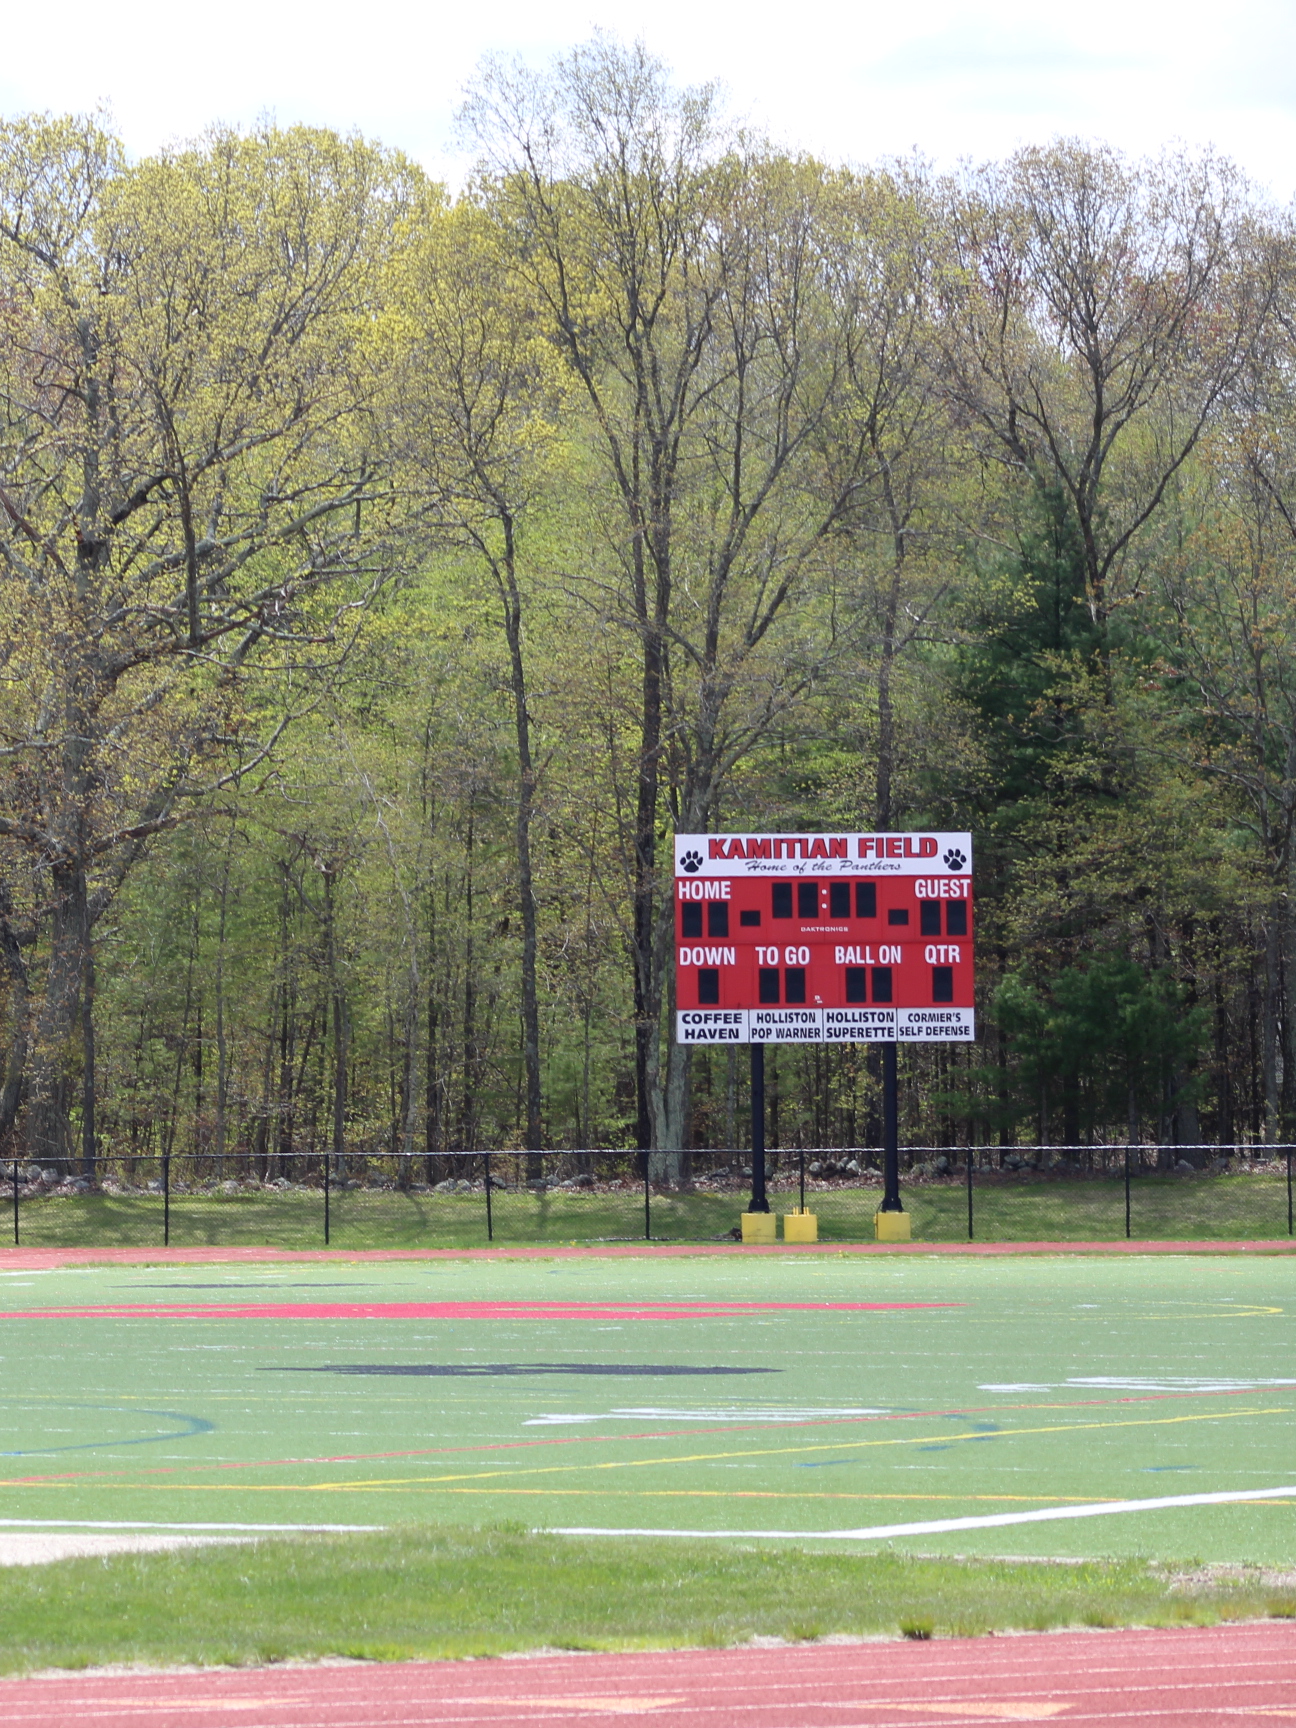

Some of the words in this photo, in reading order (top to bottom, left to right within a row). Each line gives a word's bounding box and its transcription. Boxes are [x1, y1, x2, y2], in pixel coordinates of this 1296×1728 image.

[708, 837, 848, 860] KAMITIAN
[858, 837, 939, 859] FIELD
[745, 860, 787, 873] Home
[792, 860, 808, 875] of
[811, 859, 834, 872] the
[839, 859, 902, 872] Panthers
[678, 881, 732, 900] HOME
[914, 879, 971, 898] GUEST
[679, 946, 736, 966] DOWN
[755, 946, 779, 965] TO
[785, 946, 810, 965] GO
[835, 946, 875, 965] BALL
[879, 945, 902, 964] ON
[924, 945, 961, 964] QTR
[681, 1012, 743, 1025] COFFEE
[756, 1012, 816, 1024] HOLLISTON
[826, 1011, 894, 1024] HOLLISTON
[907, 1012, 961, 1023] CORMIER'S
[684, 1027, 740, 1040] HAVEN
[751, 1028, 773, 1039] POP
[776, 1027, 821, 1039] WARNER
[826, 1027, 894, 1038] SUPERETTE
[899, 1027, 924, 1037] SELF
[926, 1026, 970, 1036] DEFENSE
